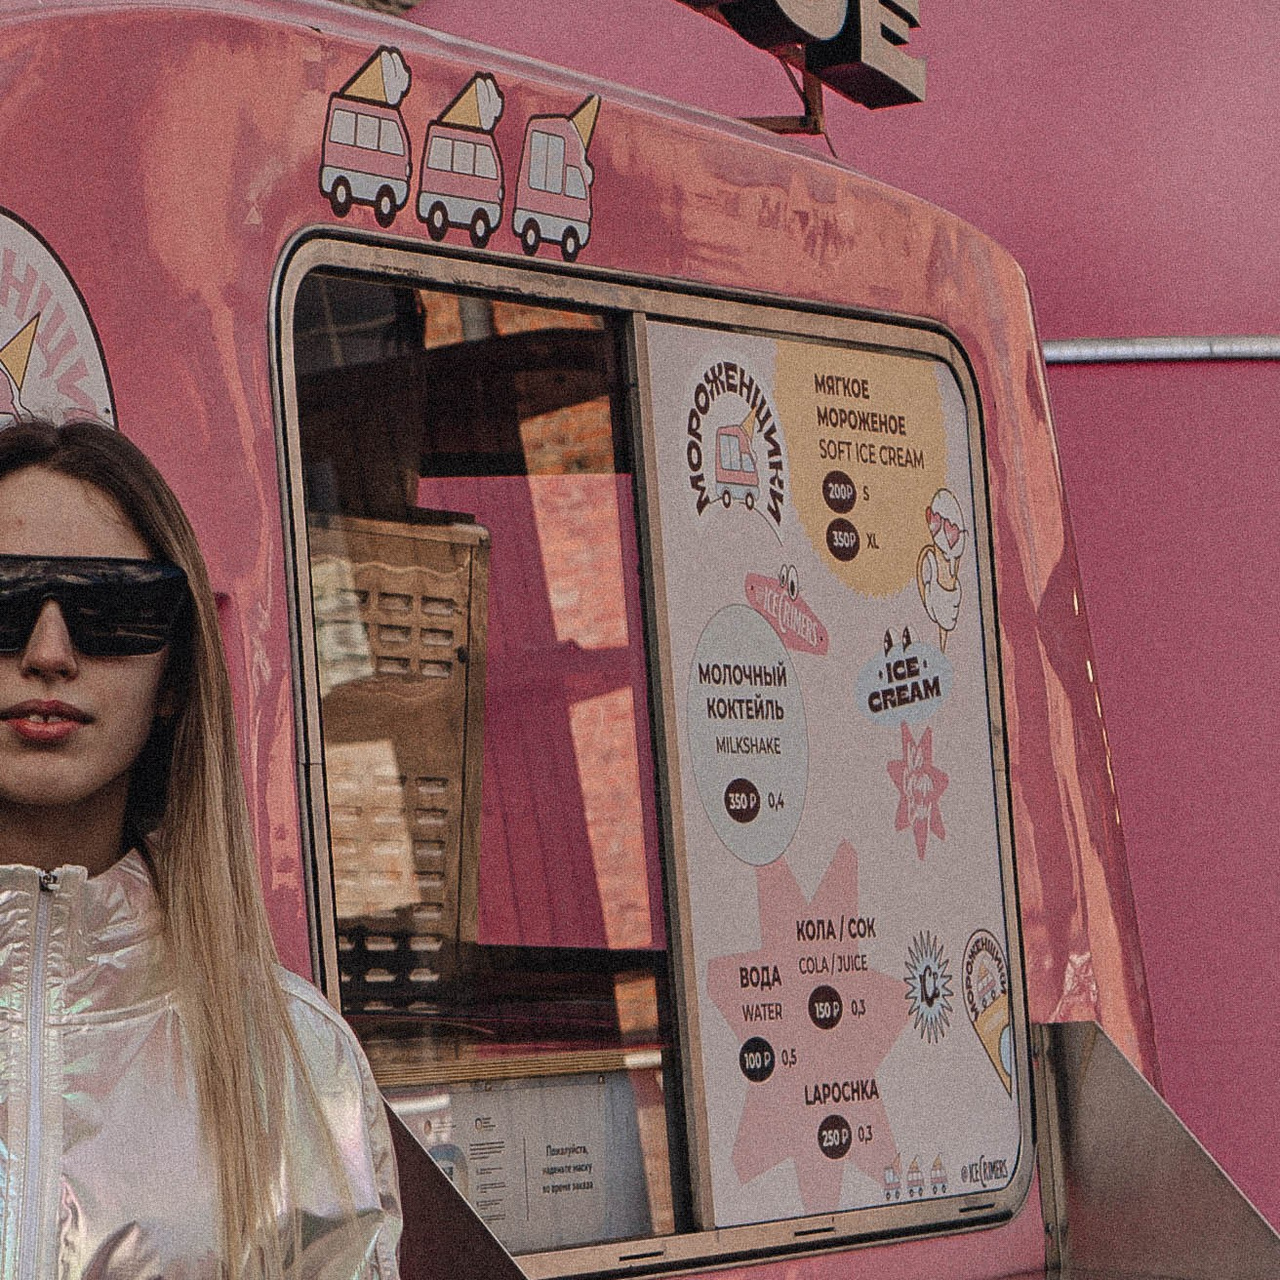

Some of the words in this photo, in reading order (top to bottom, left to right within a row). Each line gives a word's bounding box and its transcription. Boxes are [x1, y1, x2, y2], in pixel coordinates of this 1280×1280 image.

[814, 373, 870, 400] МЯГКОЕ
[816, 405, 907, 436] МОРОЖЕНОЕ
[685, 360, 786, 525] МОРОЖЕНЩИКИ
[819, 438, 852, 462] SOFT
[855, 442, 877, 464] ICE
[879, 445, 925, 469] CREAM
[863, 485, 870, 501] S
[866, 532, 880, 549] XL
[698, 660, 788, 687] МОЛОЧНЫЙ
[885, 656, 920, 683] ICE
[706, 693, 785, 721] КОКТЕЙЛЬ
[868, 675, 941, 713] CREAM
[715, 736, 782, 755] MILKSHAKE
[767, 791, 784, 811] 0,4
[796, 919, 837, 941] КОЛА
[847, 917, 877, 939] СОК
[798, 956, 829, 975] COLA
[837, 954, 869, 973] JUICE
[739, 965, 782, 991] ВОДА
[742, 1003, 783, 1021] WATER
[781, 1048, 797, 1068] 0,5
[804, 1078, 880, 1105] LAPOCHKA
